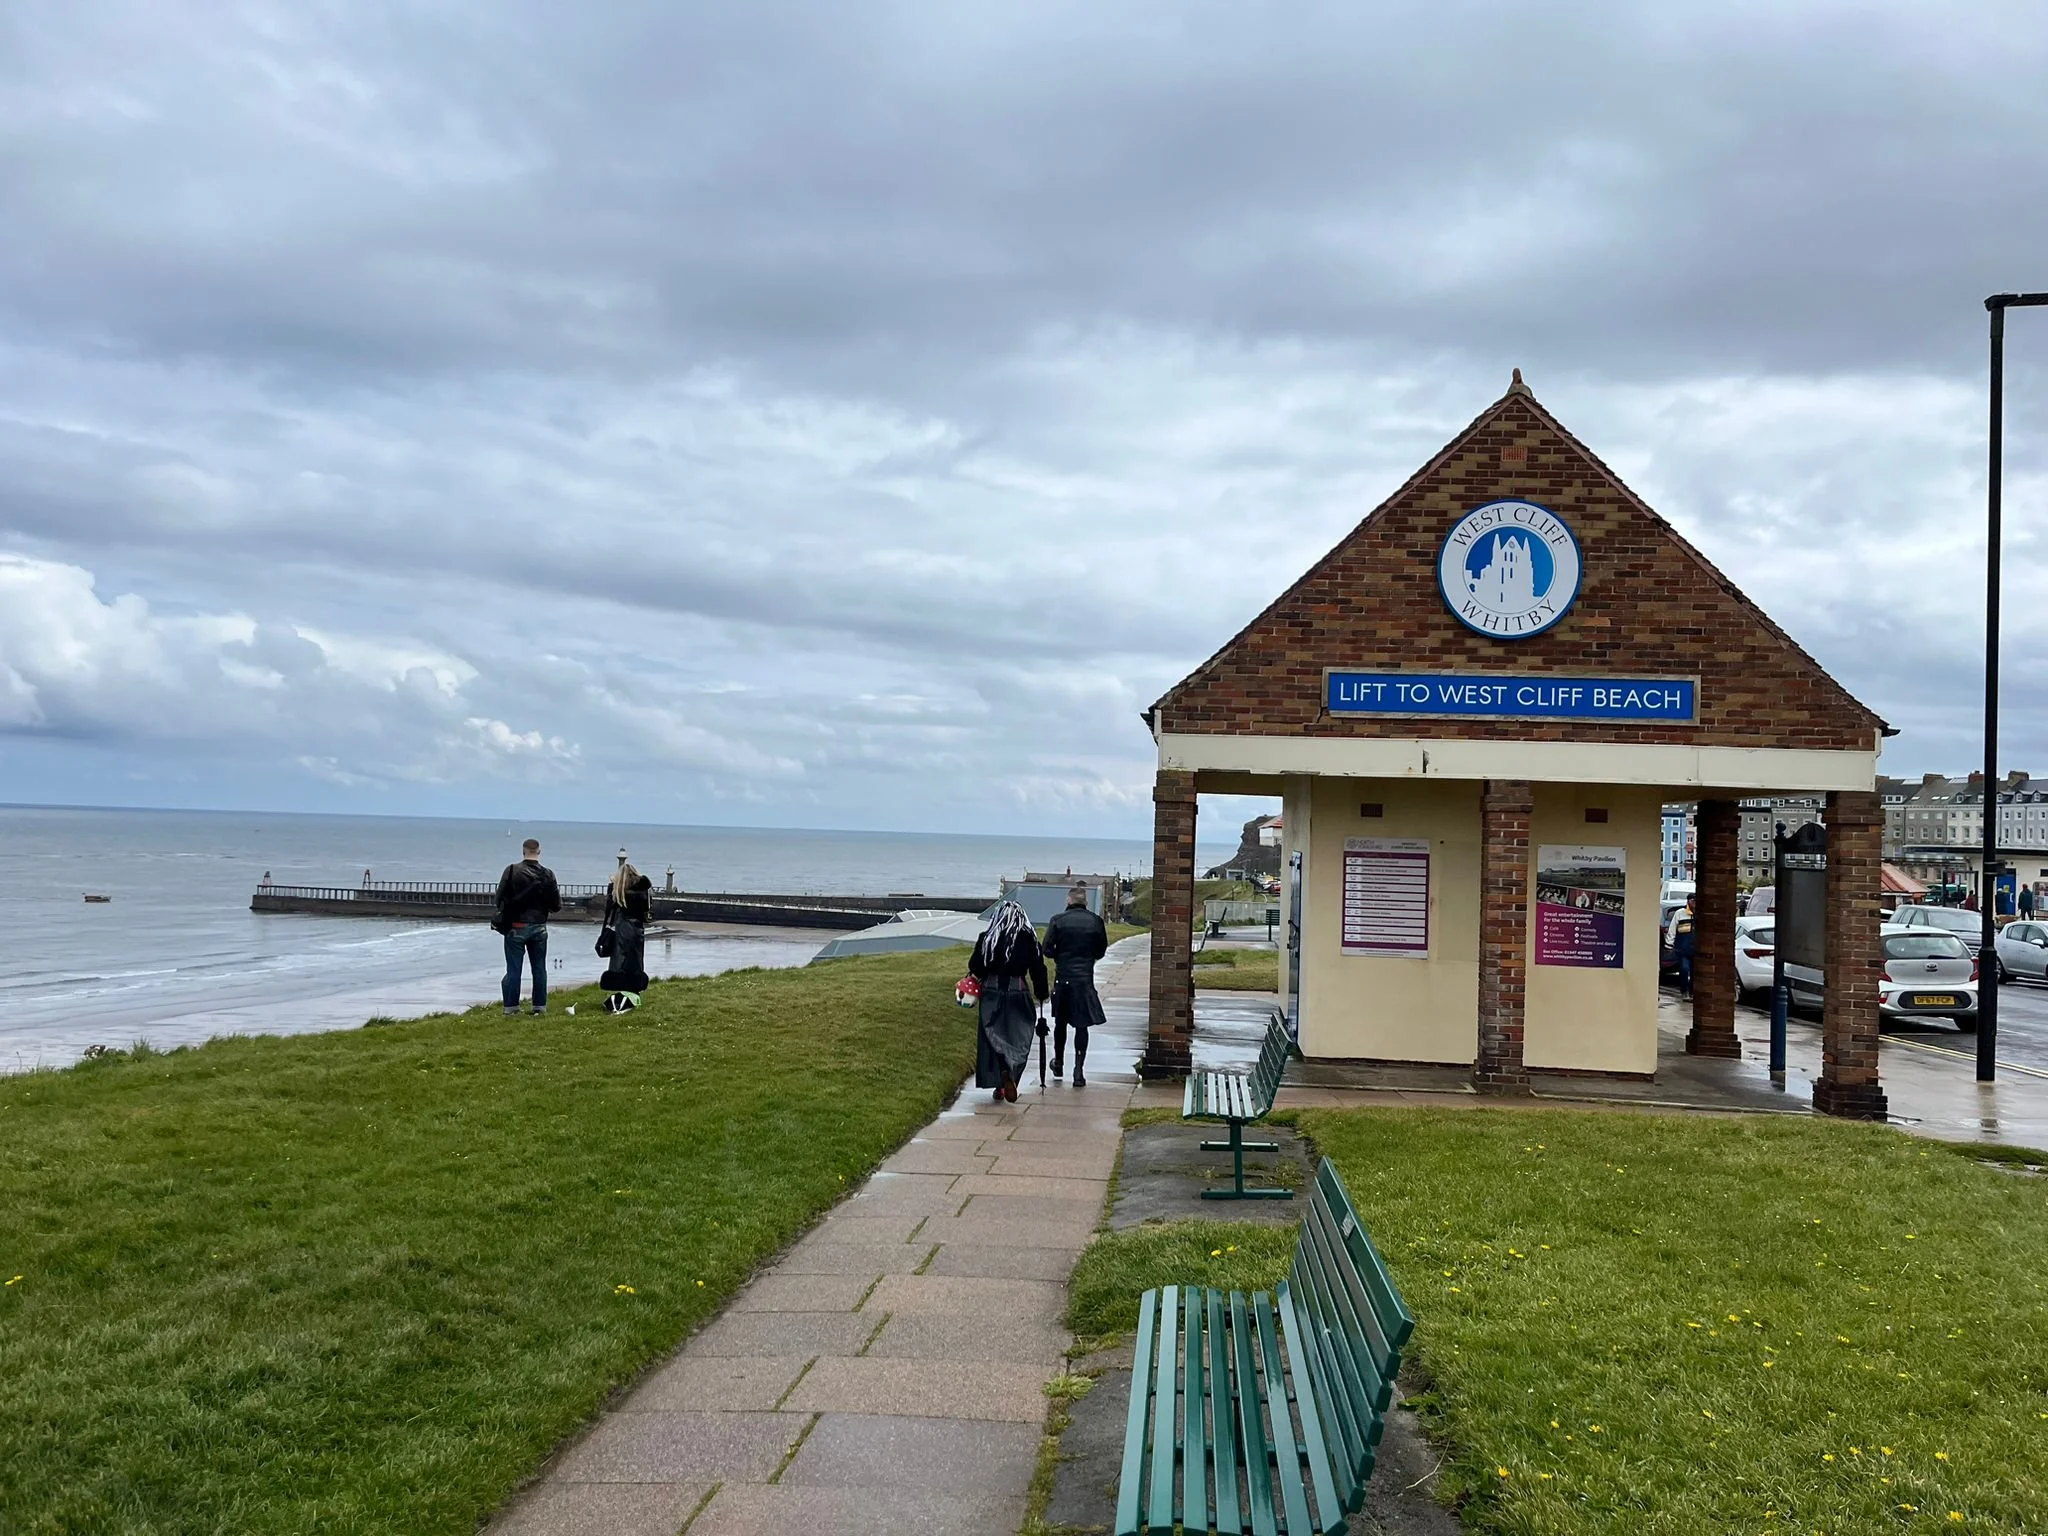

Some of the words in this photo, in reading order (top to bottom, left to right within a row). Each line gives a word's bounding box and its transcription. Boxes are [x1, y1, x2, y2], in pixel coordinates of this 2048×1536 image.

[1453, 507, 1505, 546] WEST
[1513, 507, 1567, 548] CLIFF
[1460, 599, 1557, 632] WHITBY
[1339, 682, 1387, 701] LIFT
[1395, 683, 1430, 703] TO
[1437, 684, 1507, 705] WEST
[1516, 686, 1583, 707] CLIFF
[1593, 687, 1681, 709] BEACH
